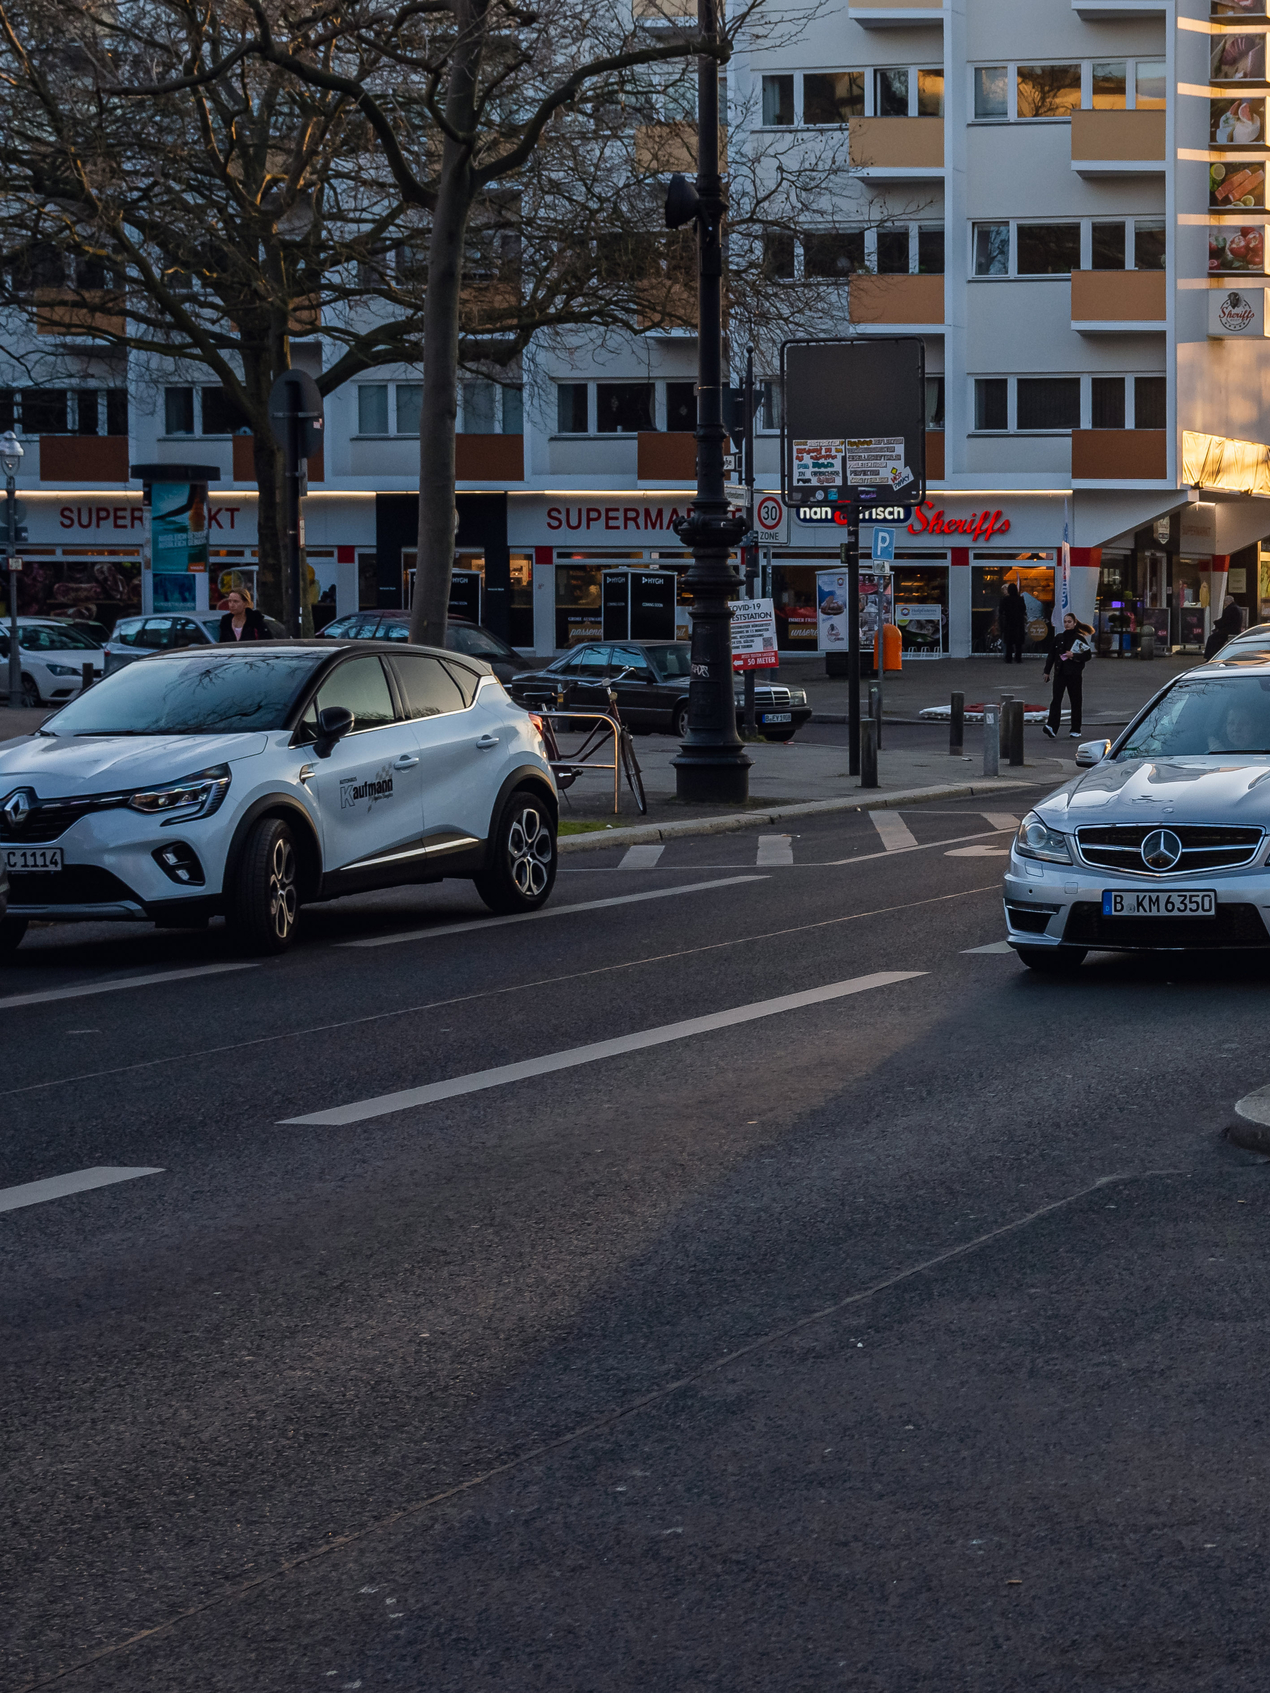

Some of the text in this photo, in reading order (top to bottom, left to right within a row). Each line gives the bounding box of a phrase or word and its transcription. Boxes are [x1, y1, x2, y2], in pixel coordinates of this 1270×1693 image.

[1218, 306, 1255, 319] Sheriffs
[59, 506, 241, 529] SUPERKT
[762, 505, 778, 521] 30
[907, 500, 1010, 542] Sheriffs
[760, 532, 780, 541] ZONE
[877, 531, 890, 555] P
[731, 611, 772, 621] ESTSTATION
[747, 658, 755, 666] 50
[340, 778, 394, 810] Kaufmann
[7, 851, 60, 868] C 1114
[1113, 894, 1125, 913] B
[1136, 894, 1161, 913] KM
[1164, 894, 1213, 913] 6350
